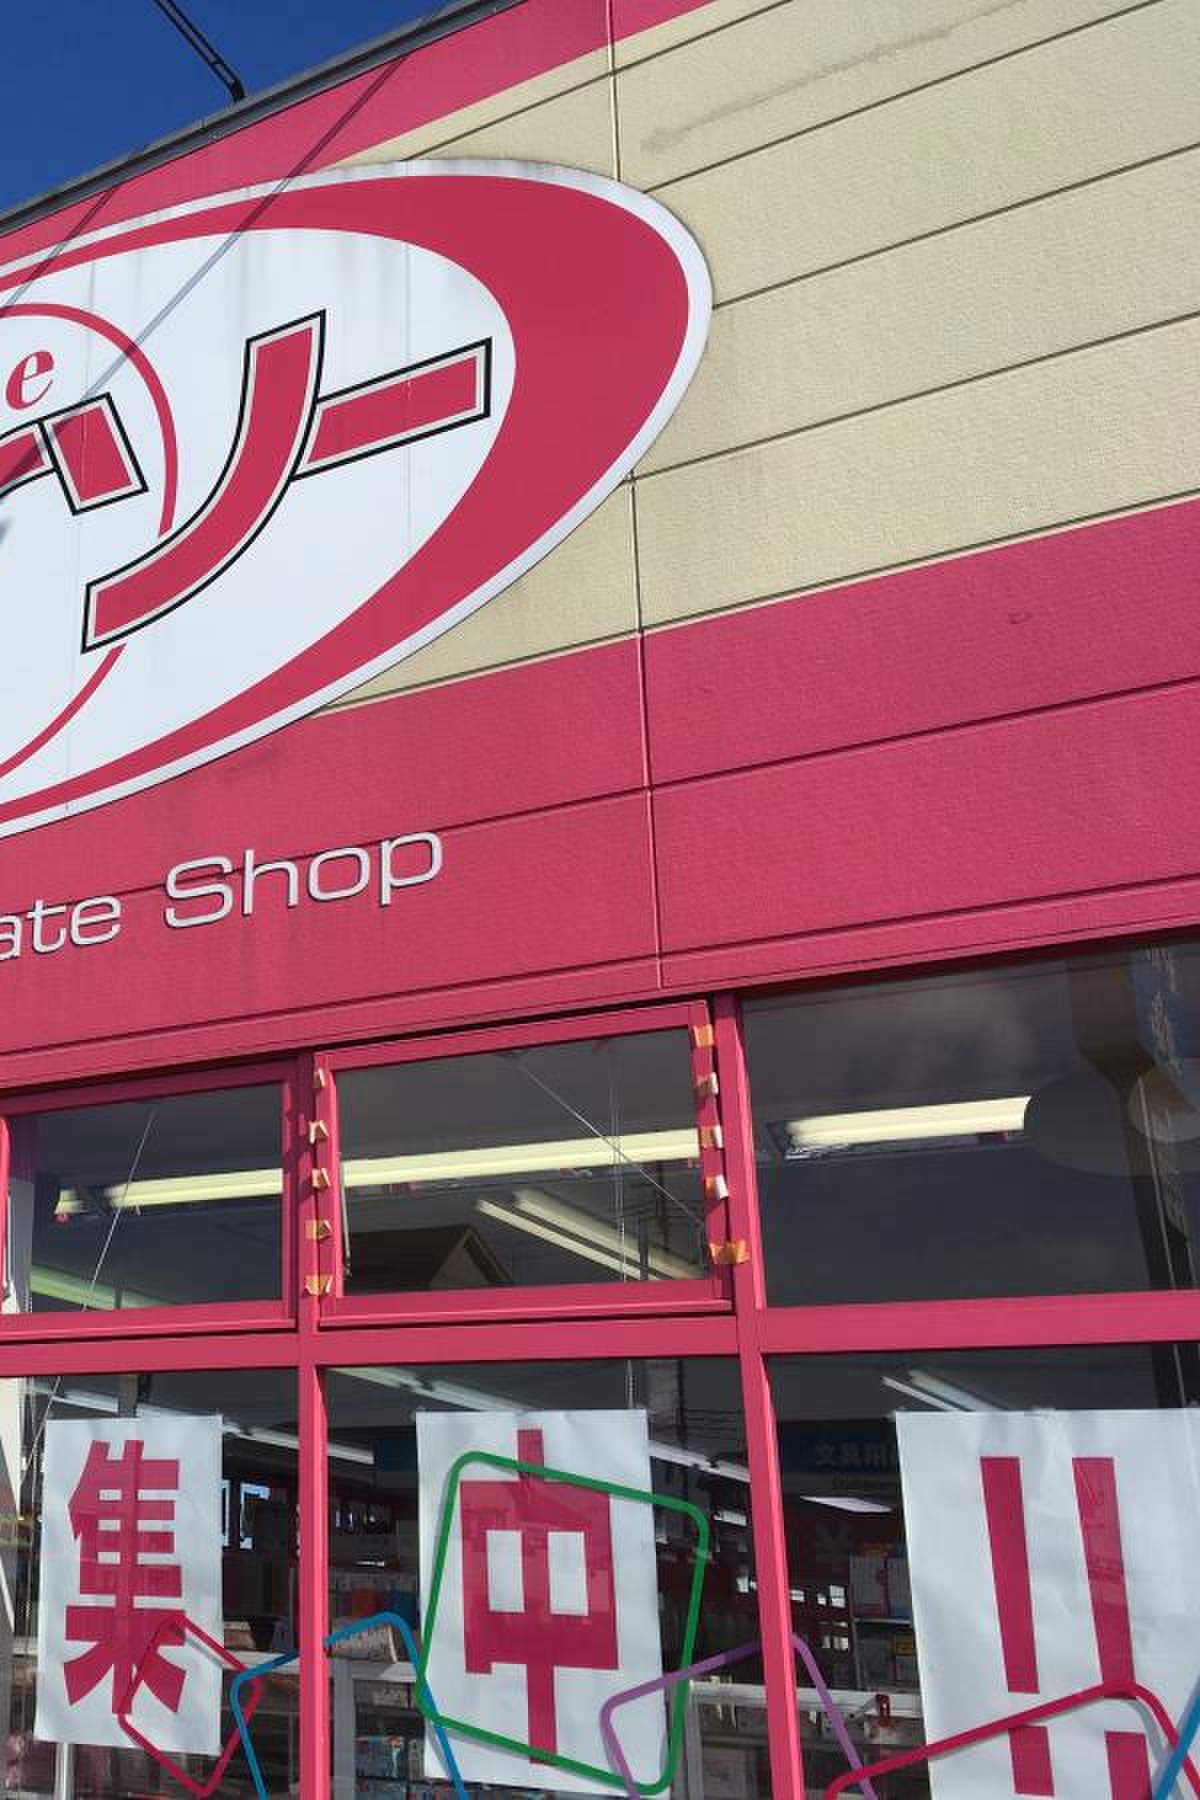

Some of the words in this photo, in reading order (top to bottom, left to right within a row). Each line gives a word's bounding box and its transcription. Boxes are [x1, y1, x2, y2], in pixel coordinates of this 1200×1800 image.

[164, 830, 443, 928] Shop
[63, 1439, 188, 1717] 集
[460, 1428, 620, 1766] 中
